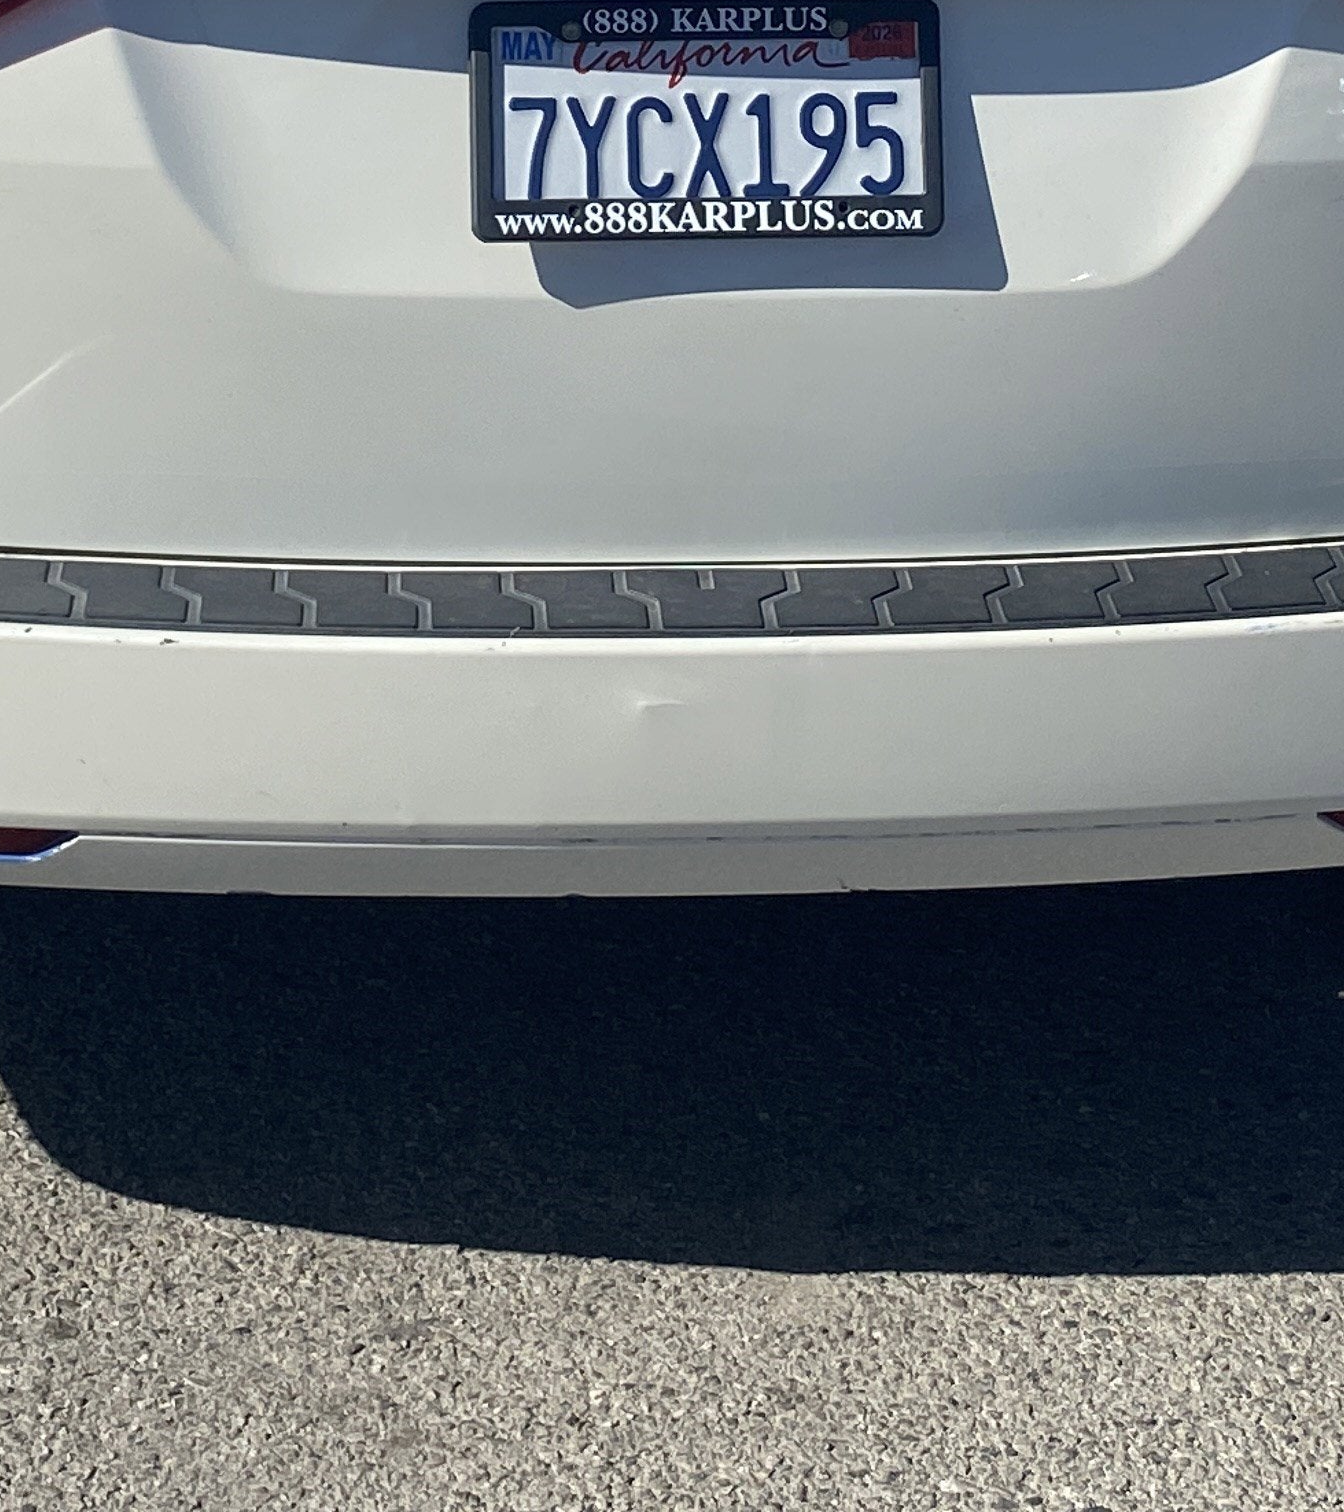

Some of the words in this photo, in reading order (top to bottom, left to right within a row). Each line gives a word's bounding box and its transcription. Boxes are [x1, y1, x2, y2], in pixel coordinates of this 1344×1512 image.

[582, 7, 659, 35] (888)
[670, 5, 828, 34] KARPLUS
[501, 31, 556, 62] MAY
[571, 39, 850, 89] California
[508, 90, 905, 199] 7YCX195
